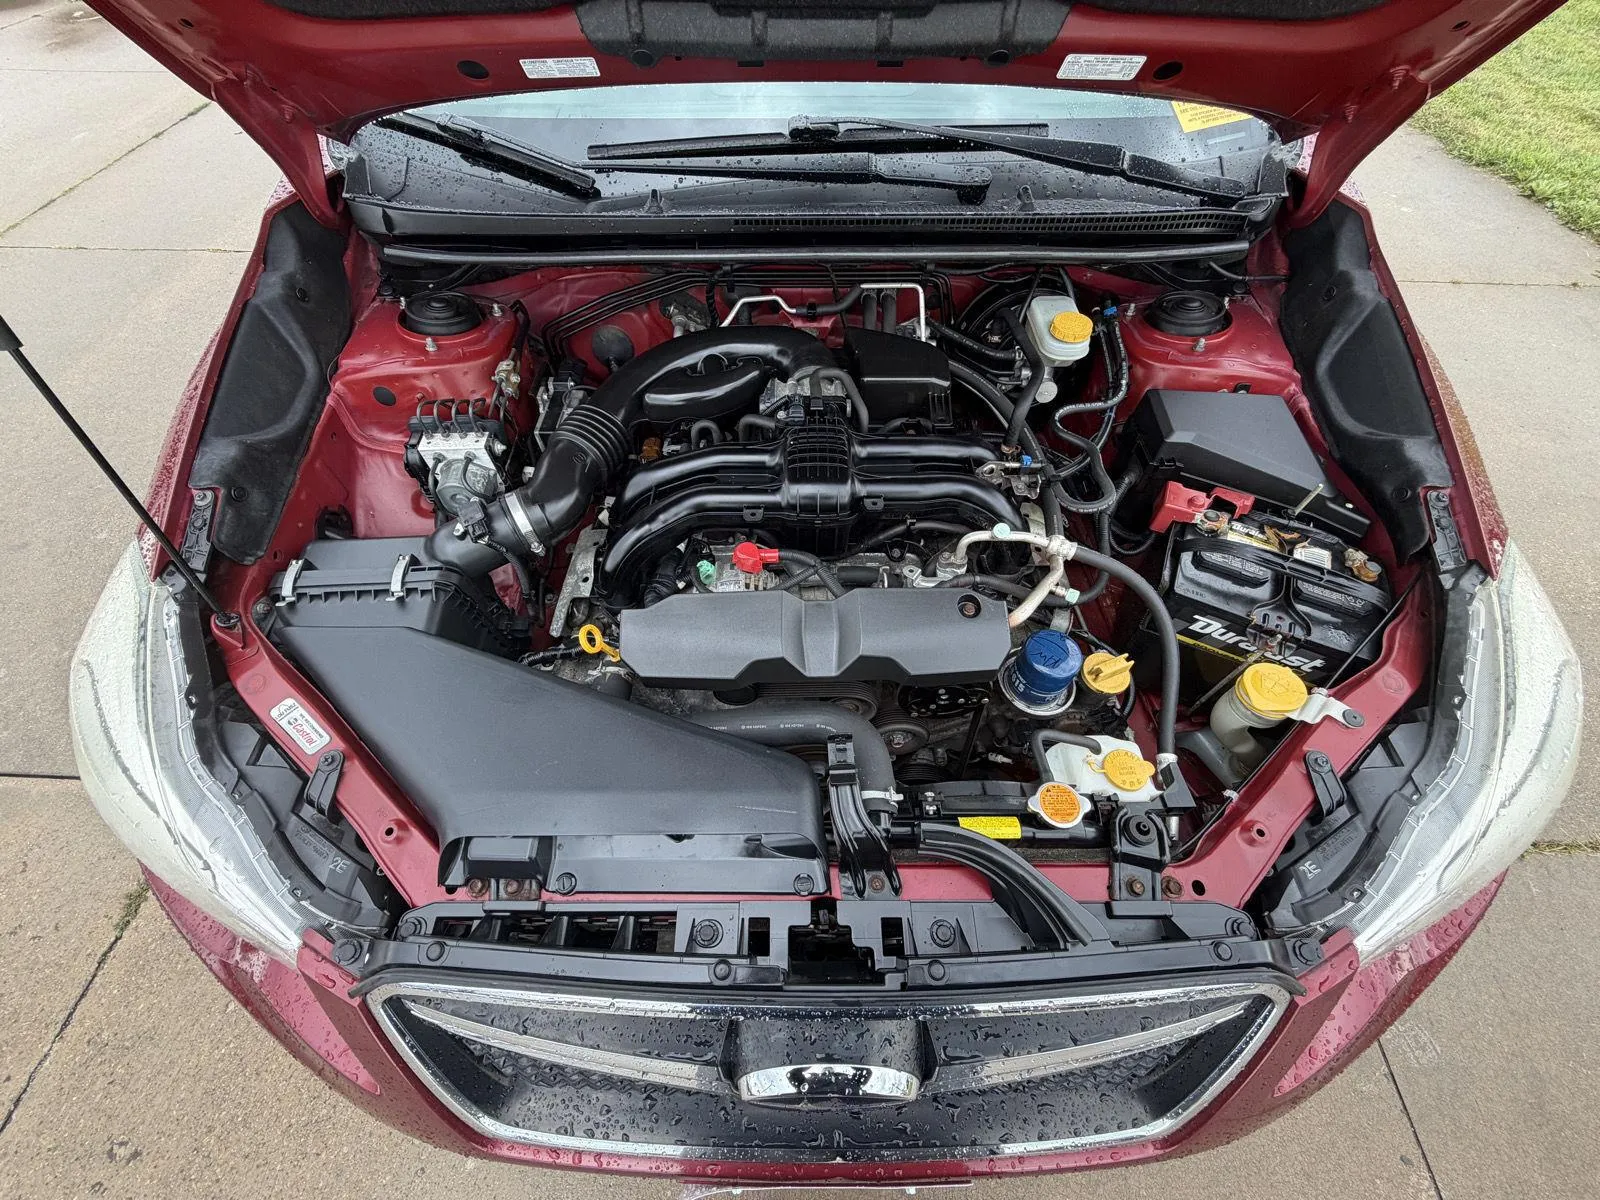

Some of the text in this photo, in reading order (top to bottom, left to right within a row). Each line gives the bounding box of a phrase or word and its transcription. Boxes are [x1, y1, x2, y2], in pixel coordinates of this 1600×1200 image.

[292, 723, 318, 746] Castrol
[328, 856, 351, 873] 2E
[1299, 861, 1323, 880] 2E
